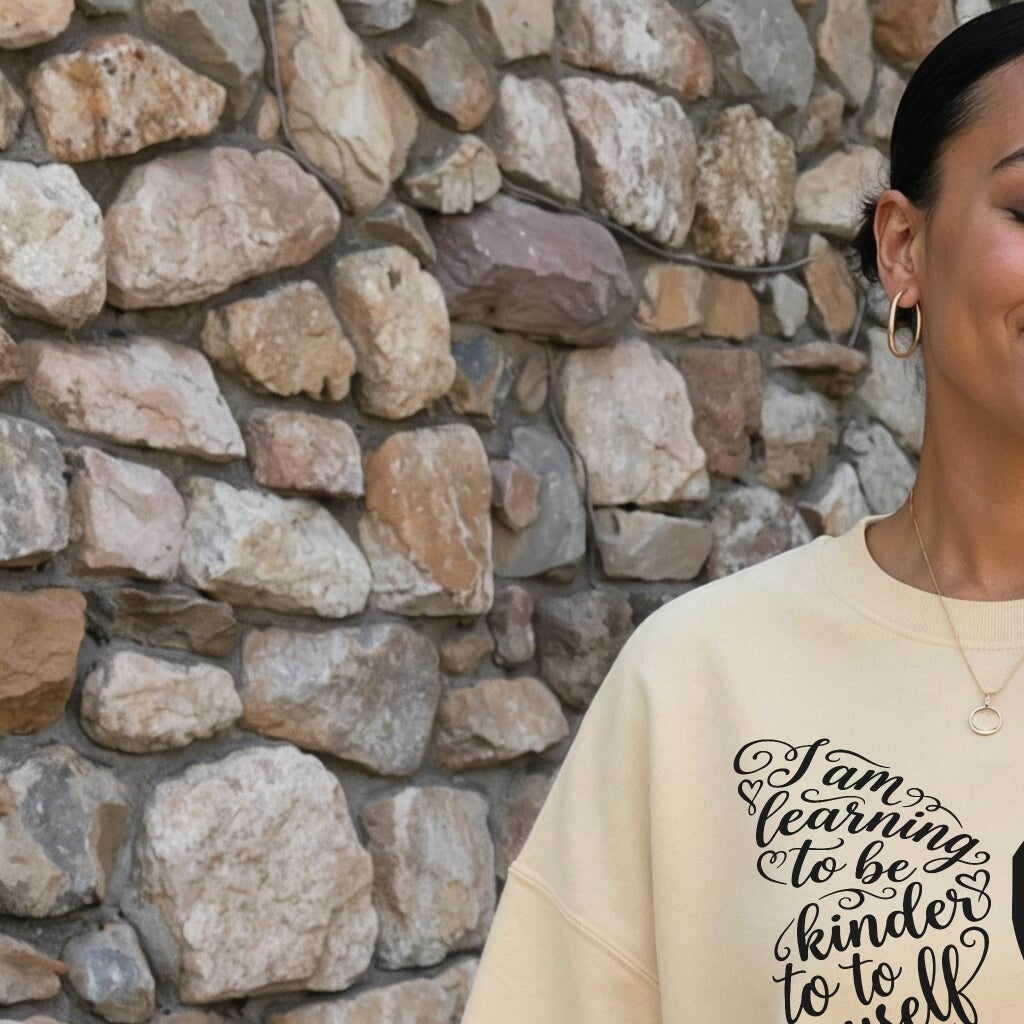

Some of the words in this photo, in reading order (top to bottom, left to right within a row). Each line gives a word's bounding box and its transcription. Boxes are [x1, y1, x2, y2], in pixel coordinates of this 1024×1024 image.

[733, 738, 831, 789] I
[821, 765, 904, 806] am
[755, 790, 991, 874] learning
[788, 837, 848, 889] to
[855, 840, 918, 885] be
[796, 881, 992, 962] kinder
[838, 952, 903, 1006] to
